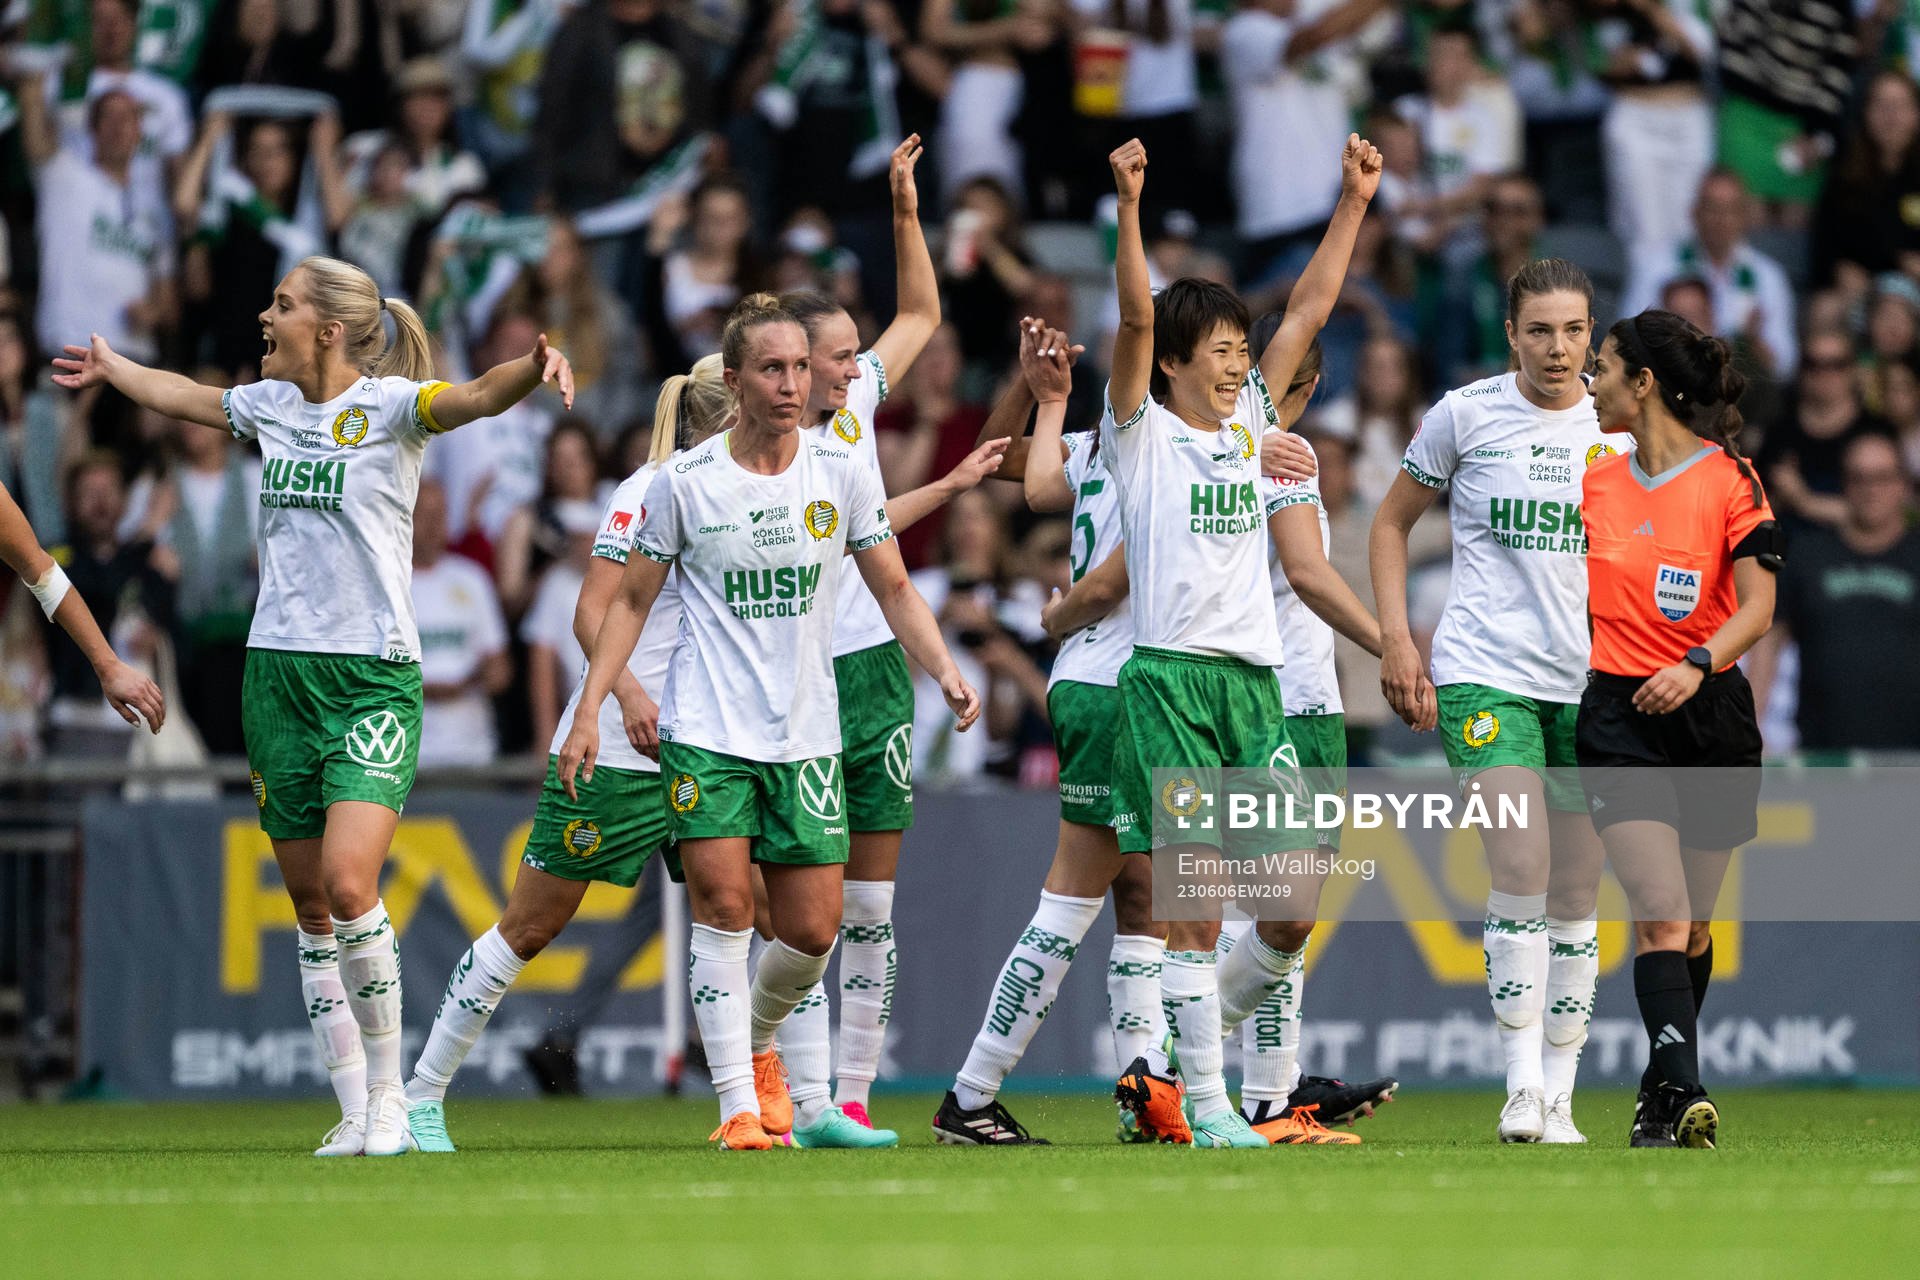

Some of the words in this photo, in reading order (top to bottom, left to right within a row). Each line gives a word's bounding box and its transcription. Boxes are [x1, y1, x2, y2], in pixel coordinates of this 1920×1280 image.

[1462, 383, 1502, 398] Convini
[675, 451, 715, 474] Convini
[1475, 450, 1506, 458] CRAFT
[262, 457, 346, 495] HUSKI
[260, 493, 343, 513] CHOCOLATE
[1490, 497, 1583, 537] HUSK
[699, 524, 731, 534] CRAFT
[1660, 569, 1696, 587] FIFA
[1658, 590, 1696, 603] REFEREE
[364, 769, 396, 782] CRAFT
[989, 957, 1045, 1037] Clinton
